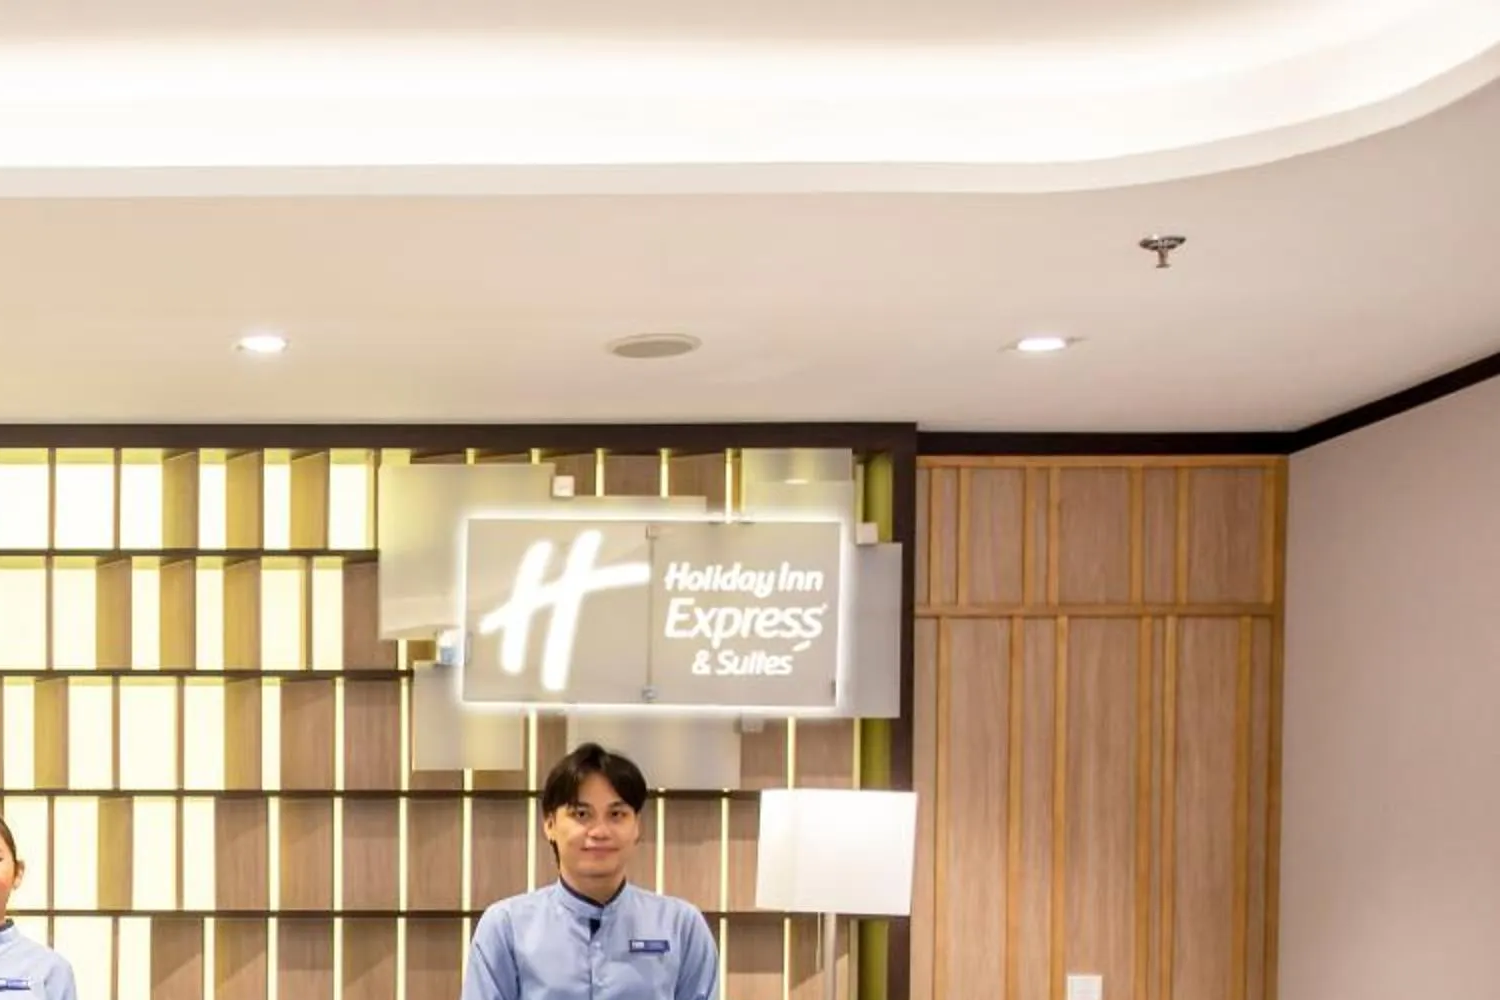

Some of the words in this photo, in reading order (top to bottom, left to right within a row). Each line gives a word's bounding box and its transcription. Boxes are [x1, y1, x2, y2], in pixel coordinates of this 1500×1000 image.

[664, 561, 776, 599] Holiday
[778, 560, 824, 592] Inn
[664, 597, 824, 650] Express
[691, 649, 711, 676] &
[714, 649, 794, 676] Suites
